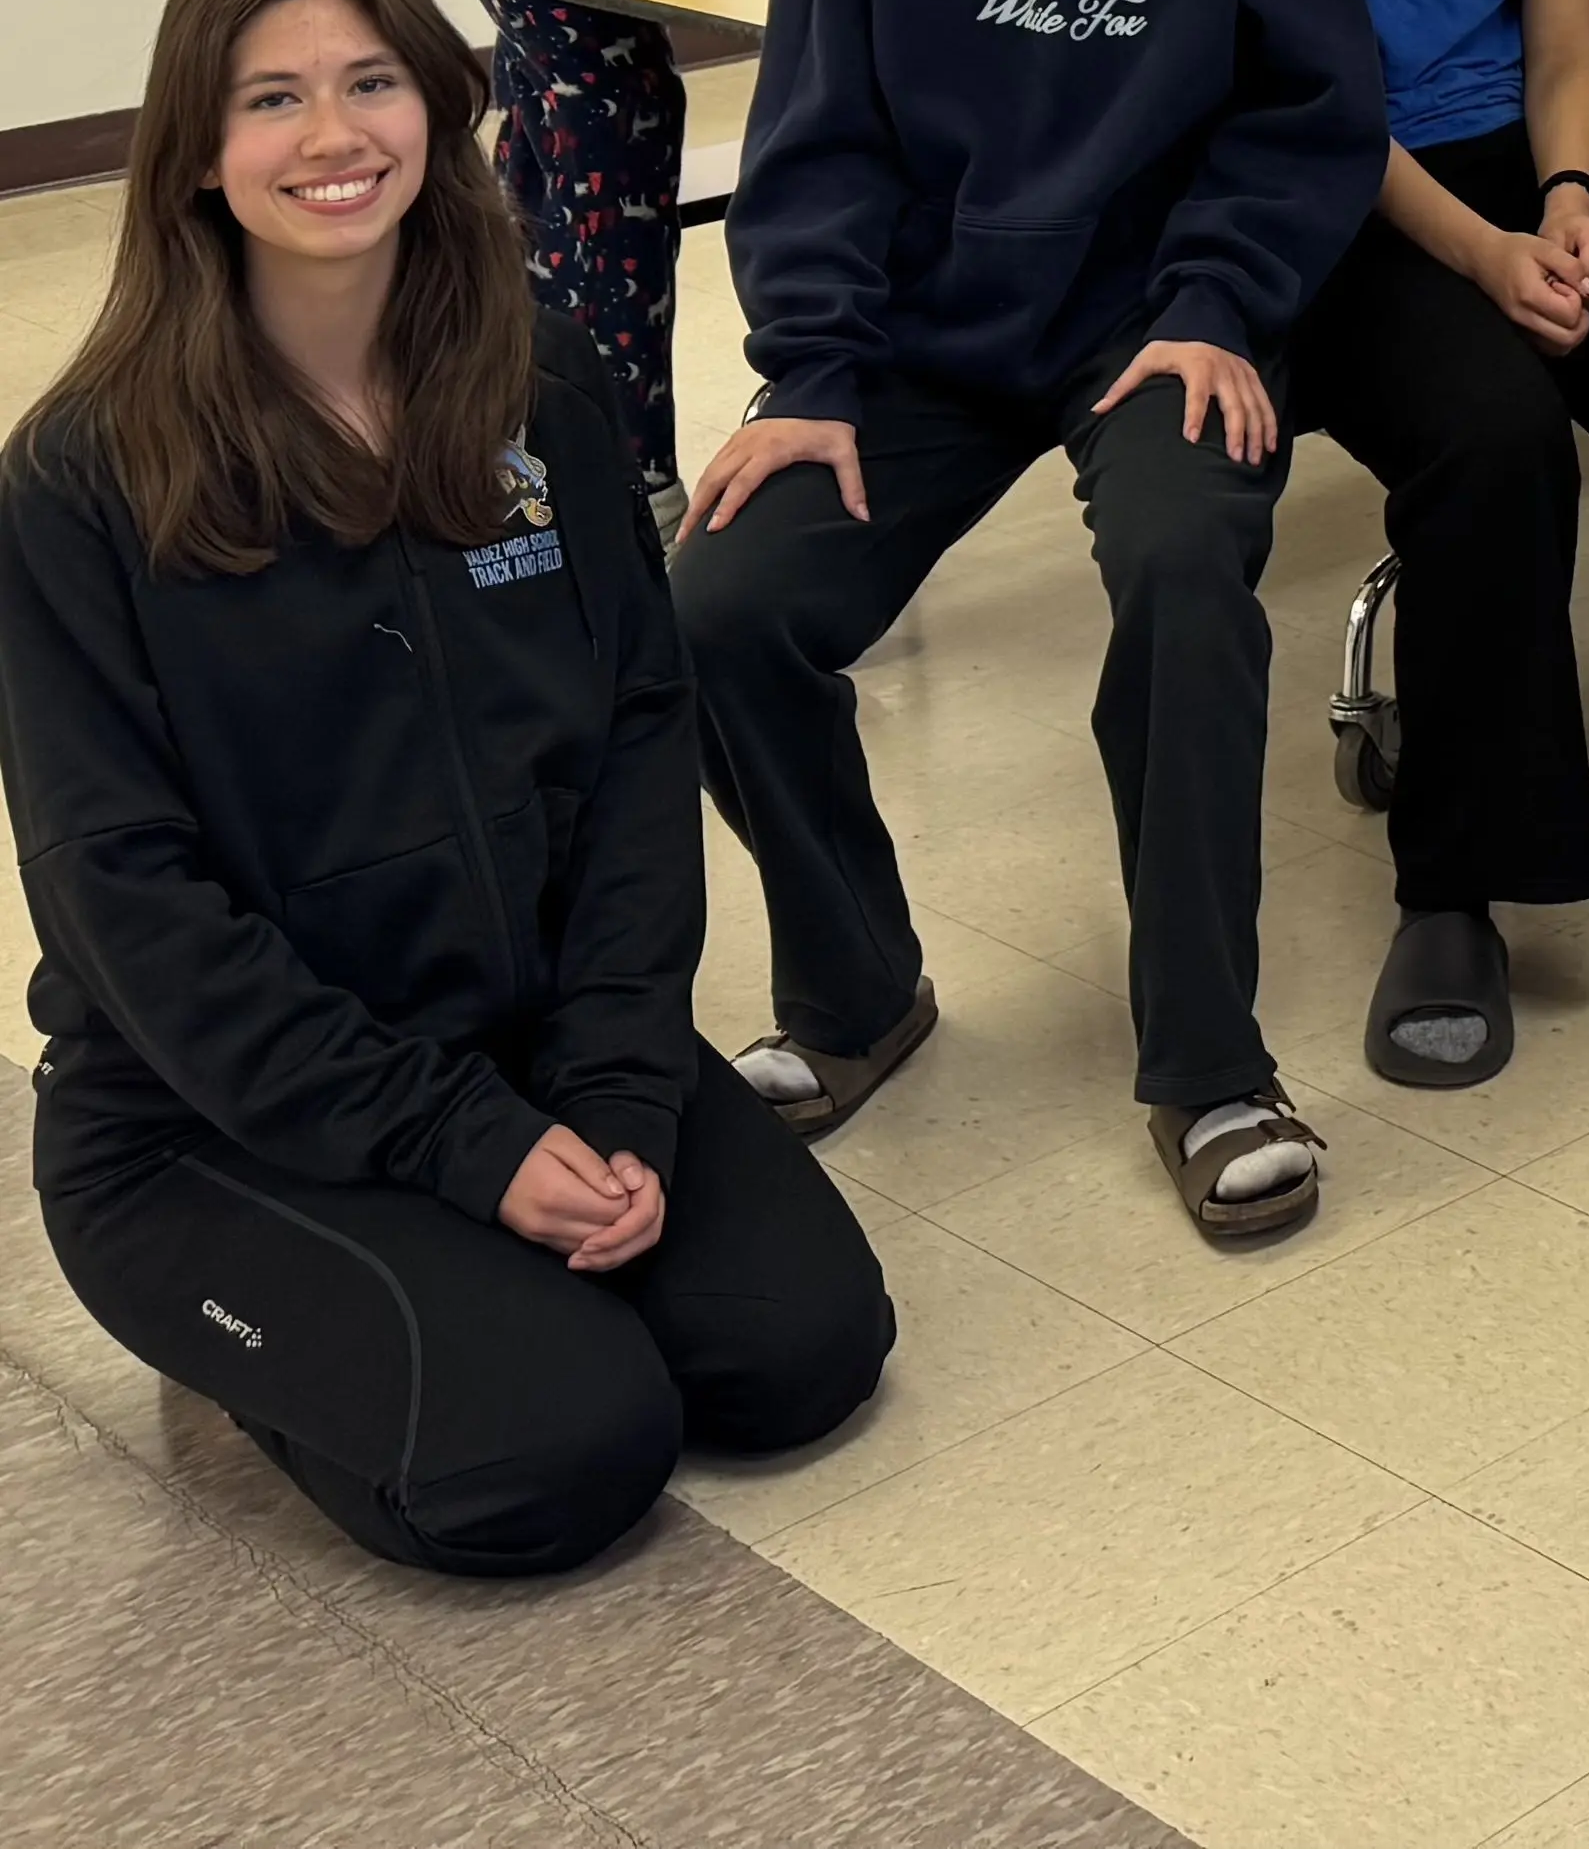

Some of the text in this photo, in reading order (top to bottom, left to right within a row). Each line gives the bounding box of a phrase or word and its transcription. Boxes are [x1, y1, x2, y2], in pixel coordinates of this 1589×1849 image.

[462, 529, 560, 567] VALDEZ HIGH SCHOOL
[468, 548, 563, 589] TRACK AND FIELD
[202, 1298, 253, 1339] CRAFT
